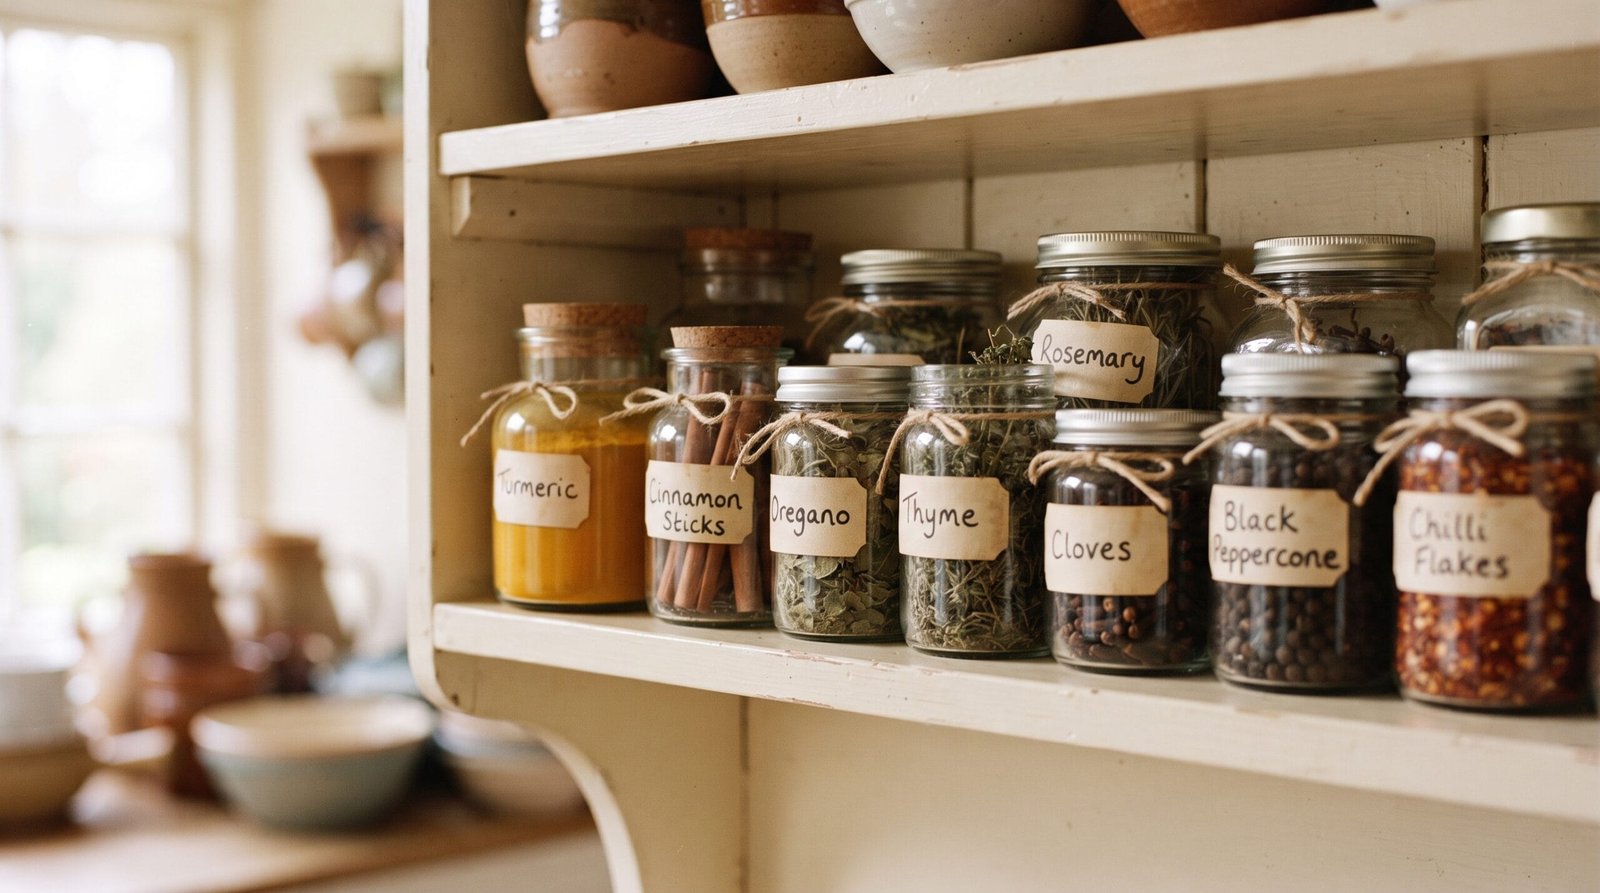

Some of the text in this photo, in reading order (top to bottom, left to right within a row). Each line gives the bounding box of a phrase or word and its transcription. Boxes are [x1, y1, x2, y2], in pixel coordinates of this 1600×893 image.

[1040, 333, 1145, 385] Rosemary
[497, 467, 578, 500] Turmeric
[649, 477, 743, 510] Cinnamon
[663, 511, 726, 536] Sticks
[771, 495, 850, 537] Oregano
[902, 491, 979, 539] Thyme
[1224, 500, 1299, 533] Black
[1409, 507, 1489, 542] Chilli
[1051, 529, 1131, 561] Cloves
[1213, 534, 1340, 575] Peppercone
[1414, 546, 1510, 579] Flakes
